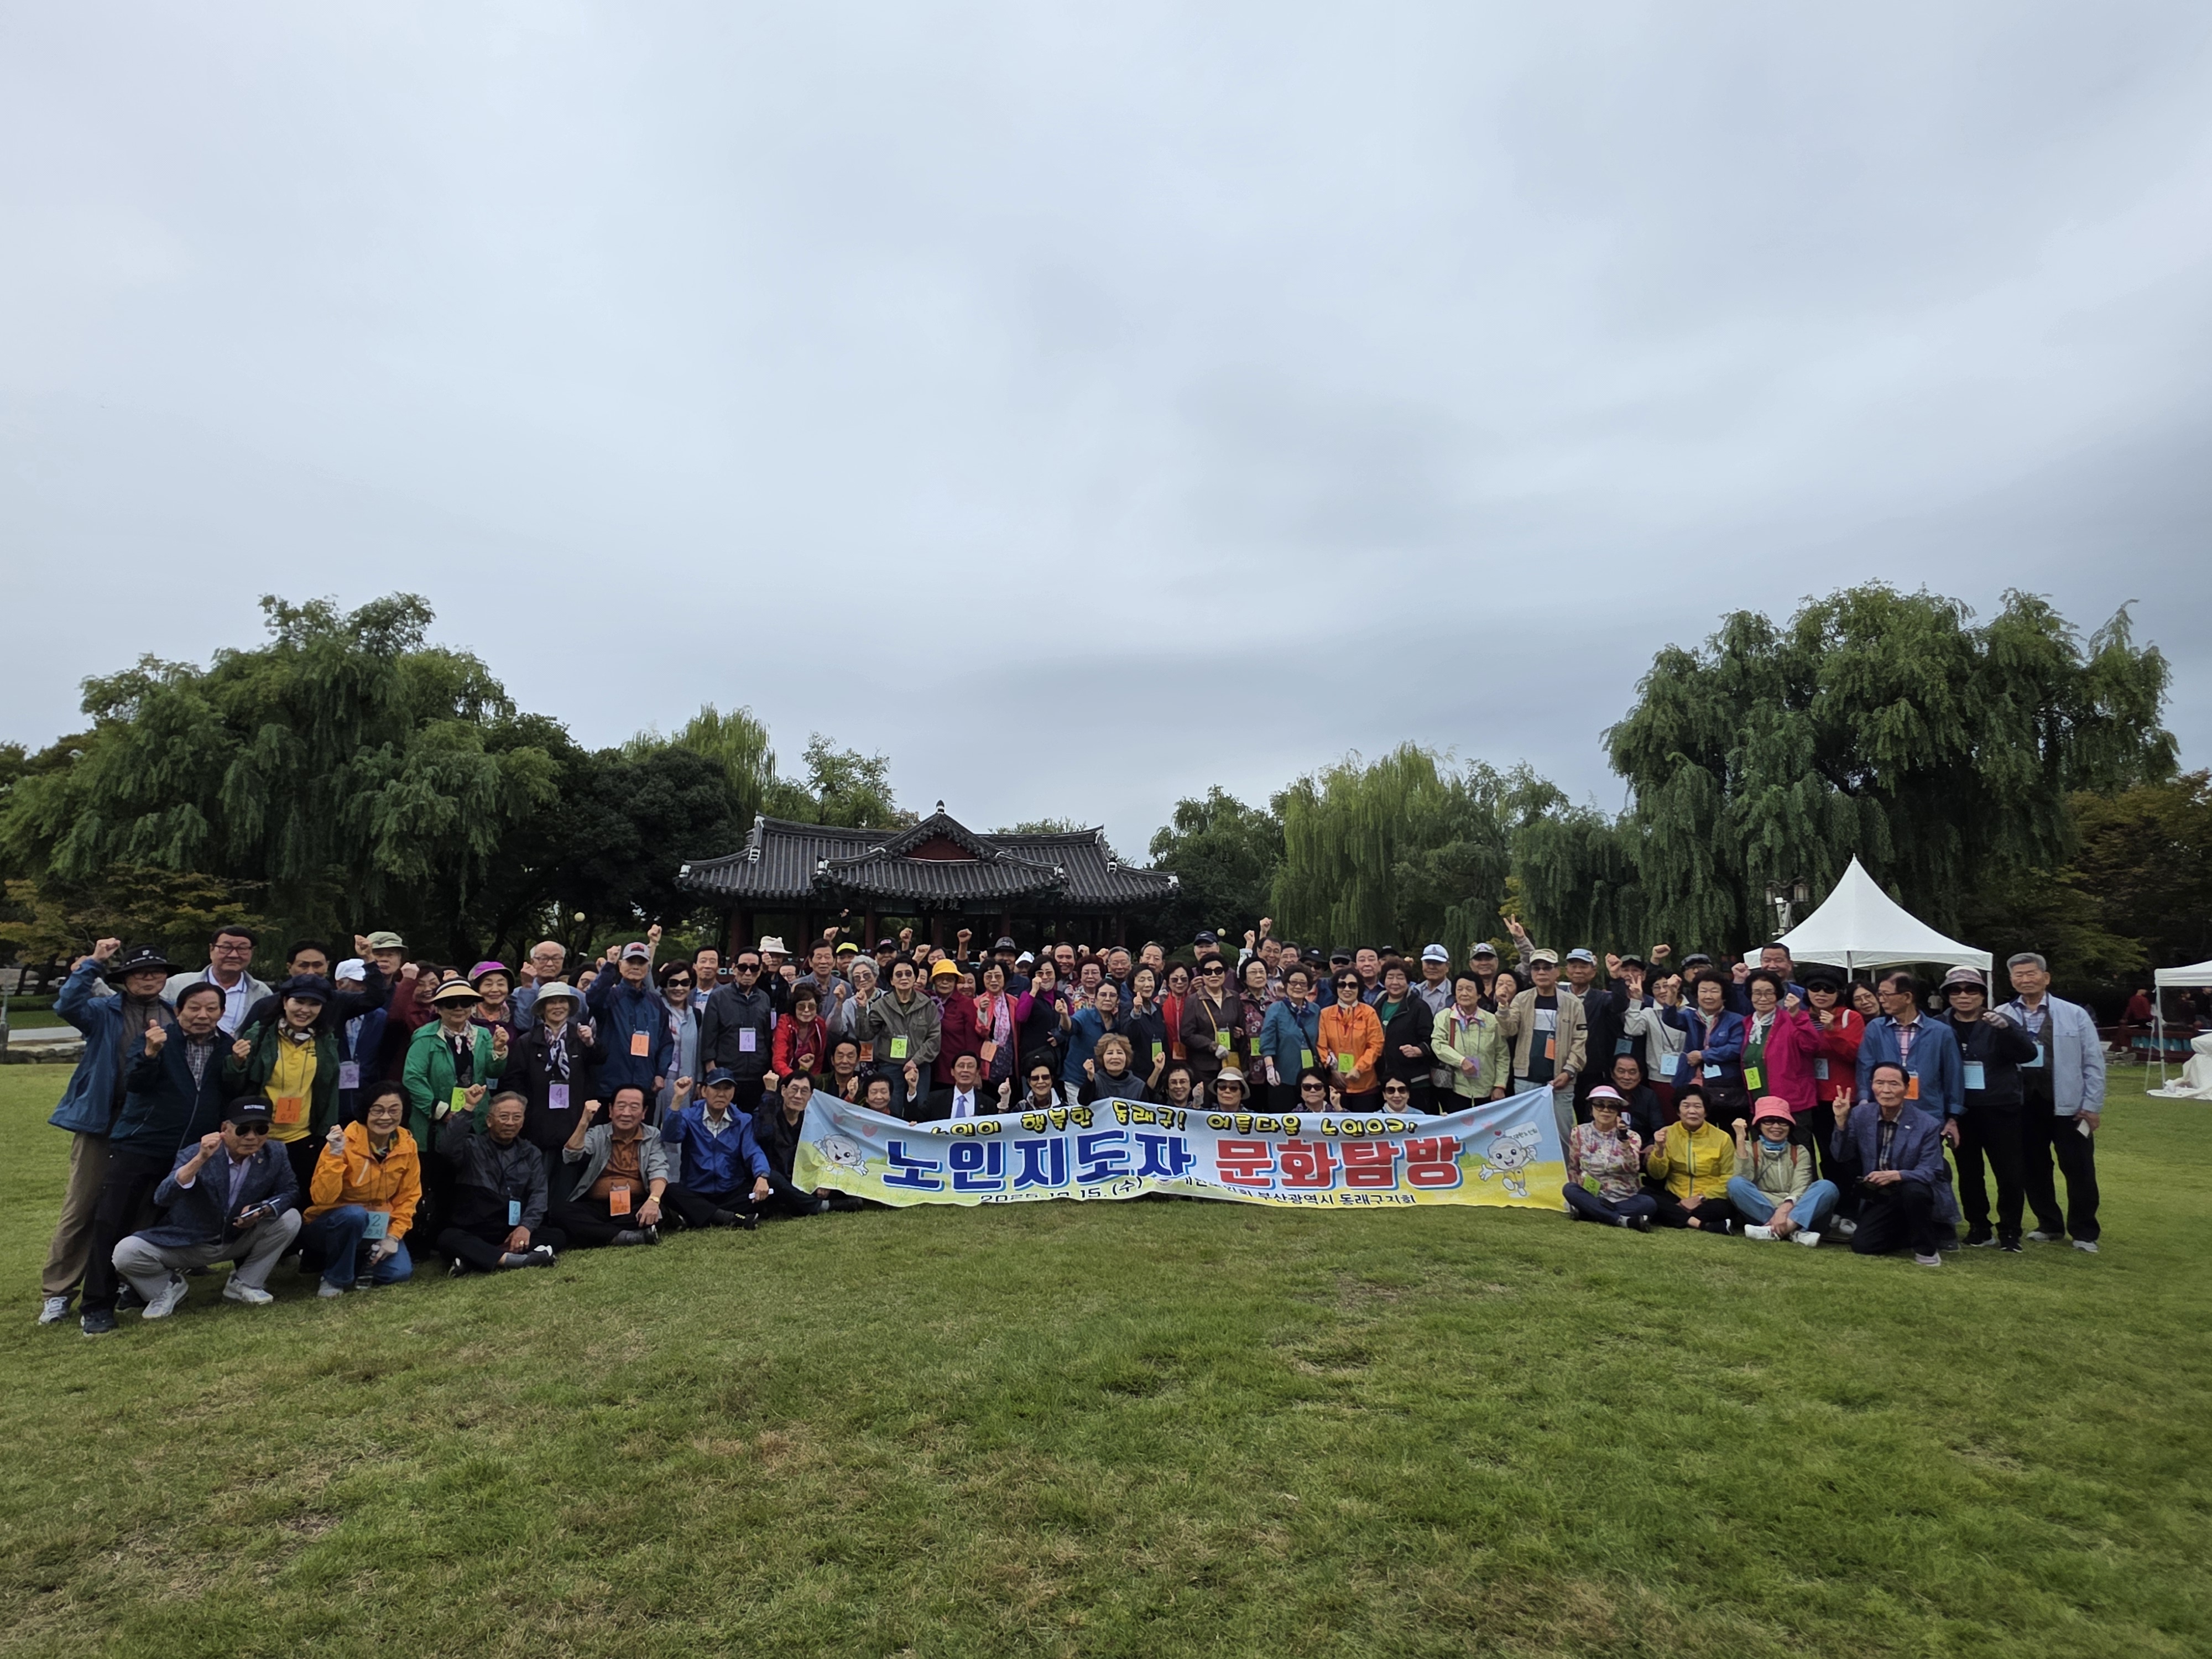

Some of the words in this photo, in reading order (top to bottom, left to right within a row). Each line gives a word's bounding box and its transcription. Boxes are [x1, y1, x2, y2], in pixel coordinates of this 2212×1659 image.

[744, 1034, 750, 1043] 4
[1220, 1034, 1225, 1042] 3
[896, 1040, 902, 1050] 3
[1620, 1041, 1627, 1051] 2
[1343, 1055, 1349, 1065] 3
[1666, 1057, 1672, 1066] 2
[1749, 1070, 1755, 1080] 3
[457, 1090, 465, 1101] 3
[556, 1088, 562, 1098] 4
[286, 1099, 292, 1112] 1
[1021, 1106, 1094, 1134] 행복한
[1112, 1100, 1187, 1131] 동래구!
[883, 1131, 1193, 1191] 노인지도자
[1216, 1138, 1463, 1188] 문화탐방
[1588, 1179, 1596, 1188] 3
[1258, 1190, 1334, 1205] 부산광역시
[1339, 1193, 1416, 1206] 동래구지회
[512, 1204, 518, 1215] 2
[372, 1214, 382, 1227] 2
